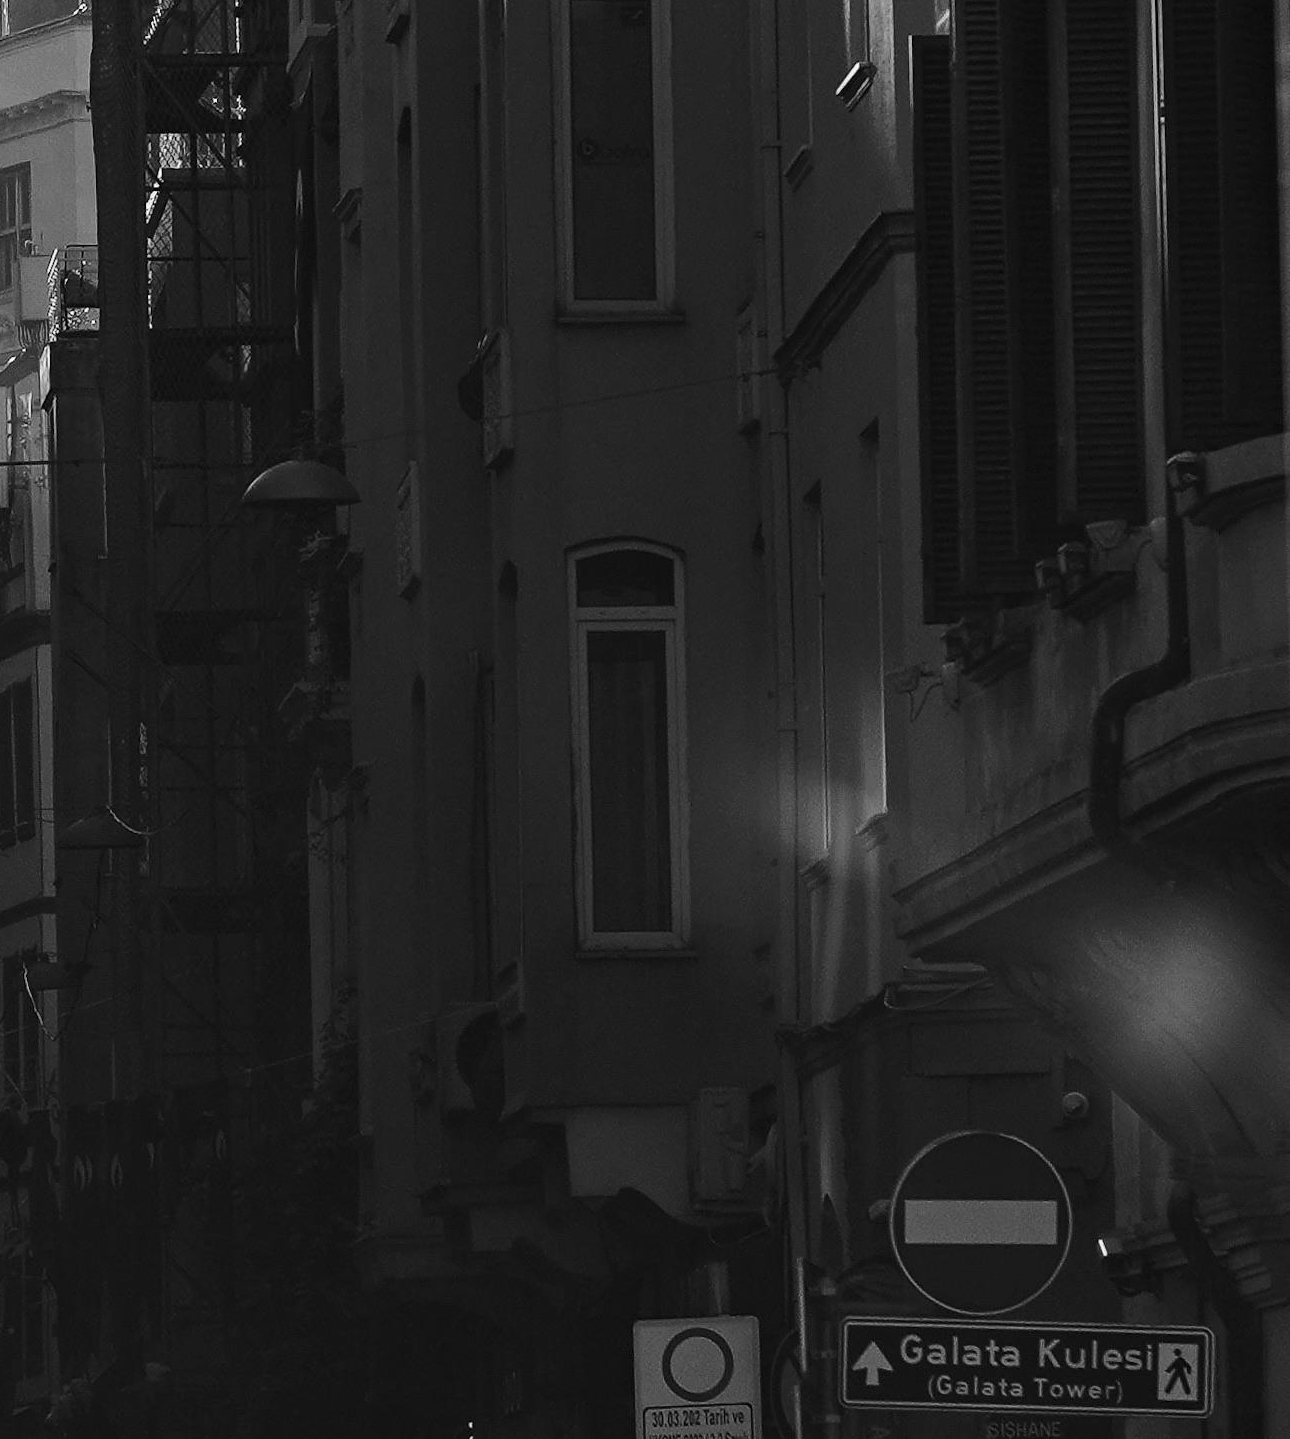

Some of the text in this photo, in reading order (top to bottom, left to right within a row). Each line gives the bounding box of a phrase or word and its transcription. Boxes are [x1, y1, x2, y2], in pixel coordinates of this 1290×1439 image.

[899, 1333, 1155, 1373] Galata Kulesi
[927, 1374, 1125, 1405] (Galata Tower)
